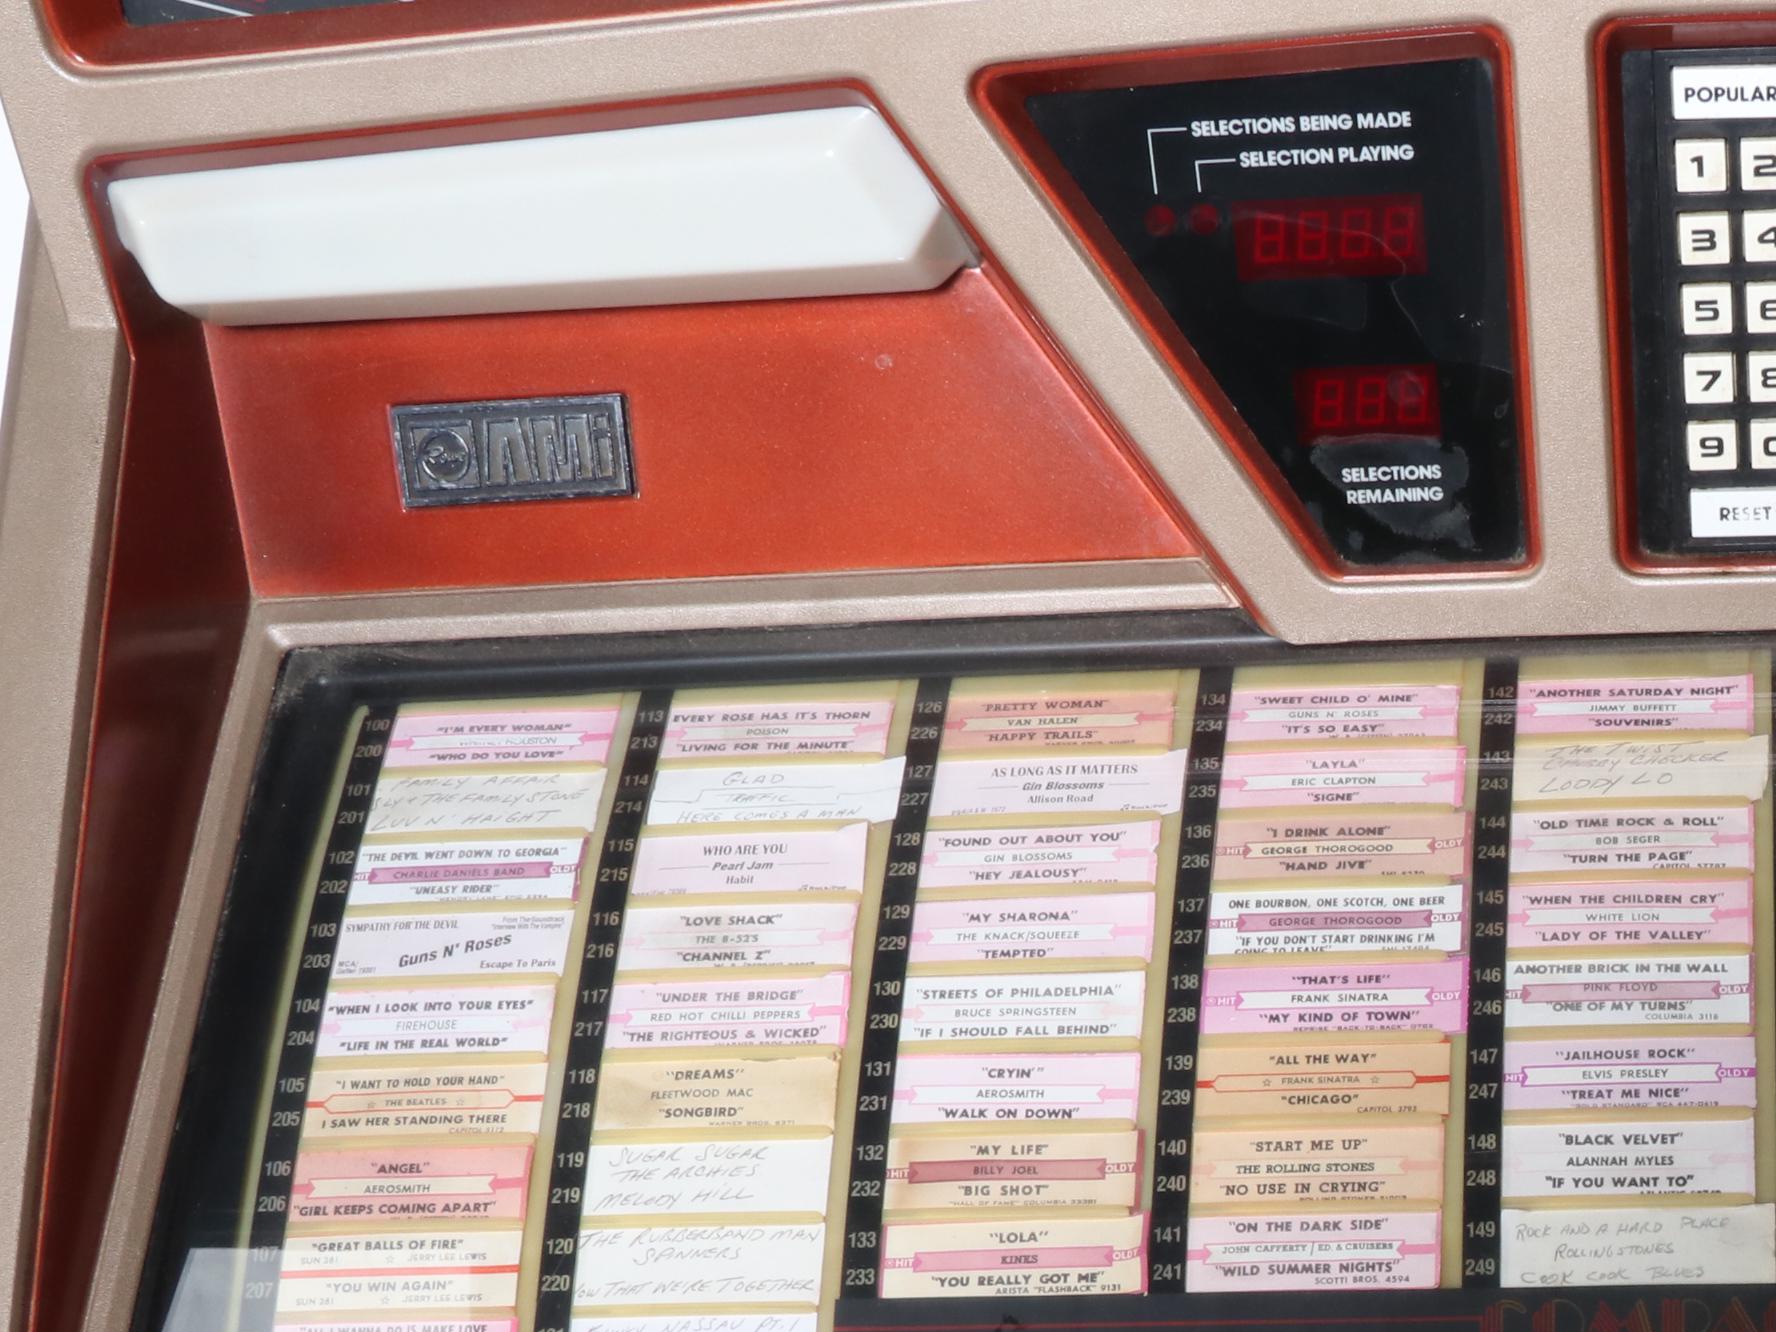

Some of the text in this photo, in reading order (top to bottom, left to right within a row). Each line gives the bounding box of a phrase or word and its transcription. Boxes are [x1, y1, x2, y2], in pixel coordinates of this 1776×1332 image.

[1190, 111, 1412, 138] SELECTIONS BEING MADE
[1239, 144, 1415, 168] SELECTION PLAYING
[1690, 155, 1704, 178] 1
[1691, 229, 1717, 252] 3
[1694, 299, 1720, 322] 5
[1696, 370, 1722, 392] 7
[1699, 436, 1724, 458] 9
[1341, 464, 1442, 483] SELECTIONS
[1346, 486, 1444, 505] REMAINING
[1719, 506, 1772, 521] RESET
[991, 764, 1138, 778] AS LONG AS IT MATTERS
[1291, 776, 1376, 786] ERIC CLAPTON
[703, 843, 788, 856] WHO ARE YOU
[1228, 899, 1251, 909] ONE
[1316, 897, 1338, 908] ONE
[1392, 897, 1415, 907] ONE
[1419, 895, 1446, 906] BEER
[883, 904, 911, 919] 129
[1585, 912, 1660, 922] WHITE LION
[1513, 963, 1729, 975] ANOTHER BRICK IN THE WALL
[1290, 992, 1389, 1004] FRANK SINATRA
[650, 1009, 806, 1022] RED HOT CHILLI PEPPERS
[568, 1068, 596, 1084] 118
[1467, 1133, 1497, 1153] 148
[1235, 1162, 1375, 1175] THE ROLLING STONES
[1566, 1155, 1674, 1167] ALANNAH MYLES
